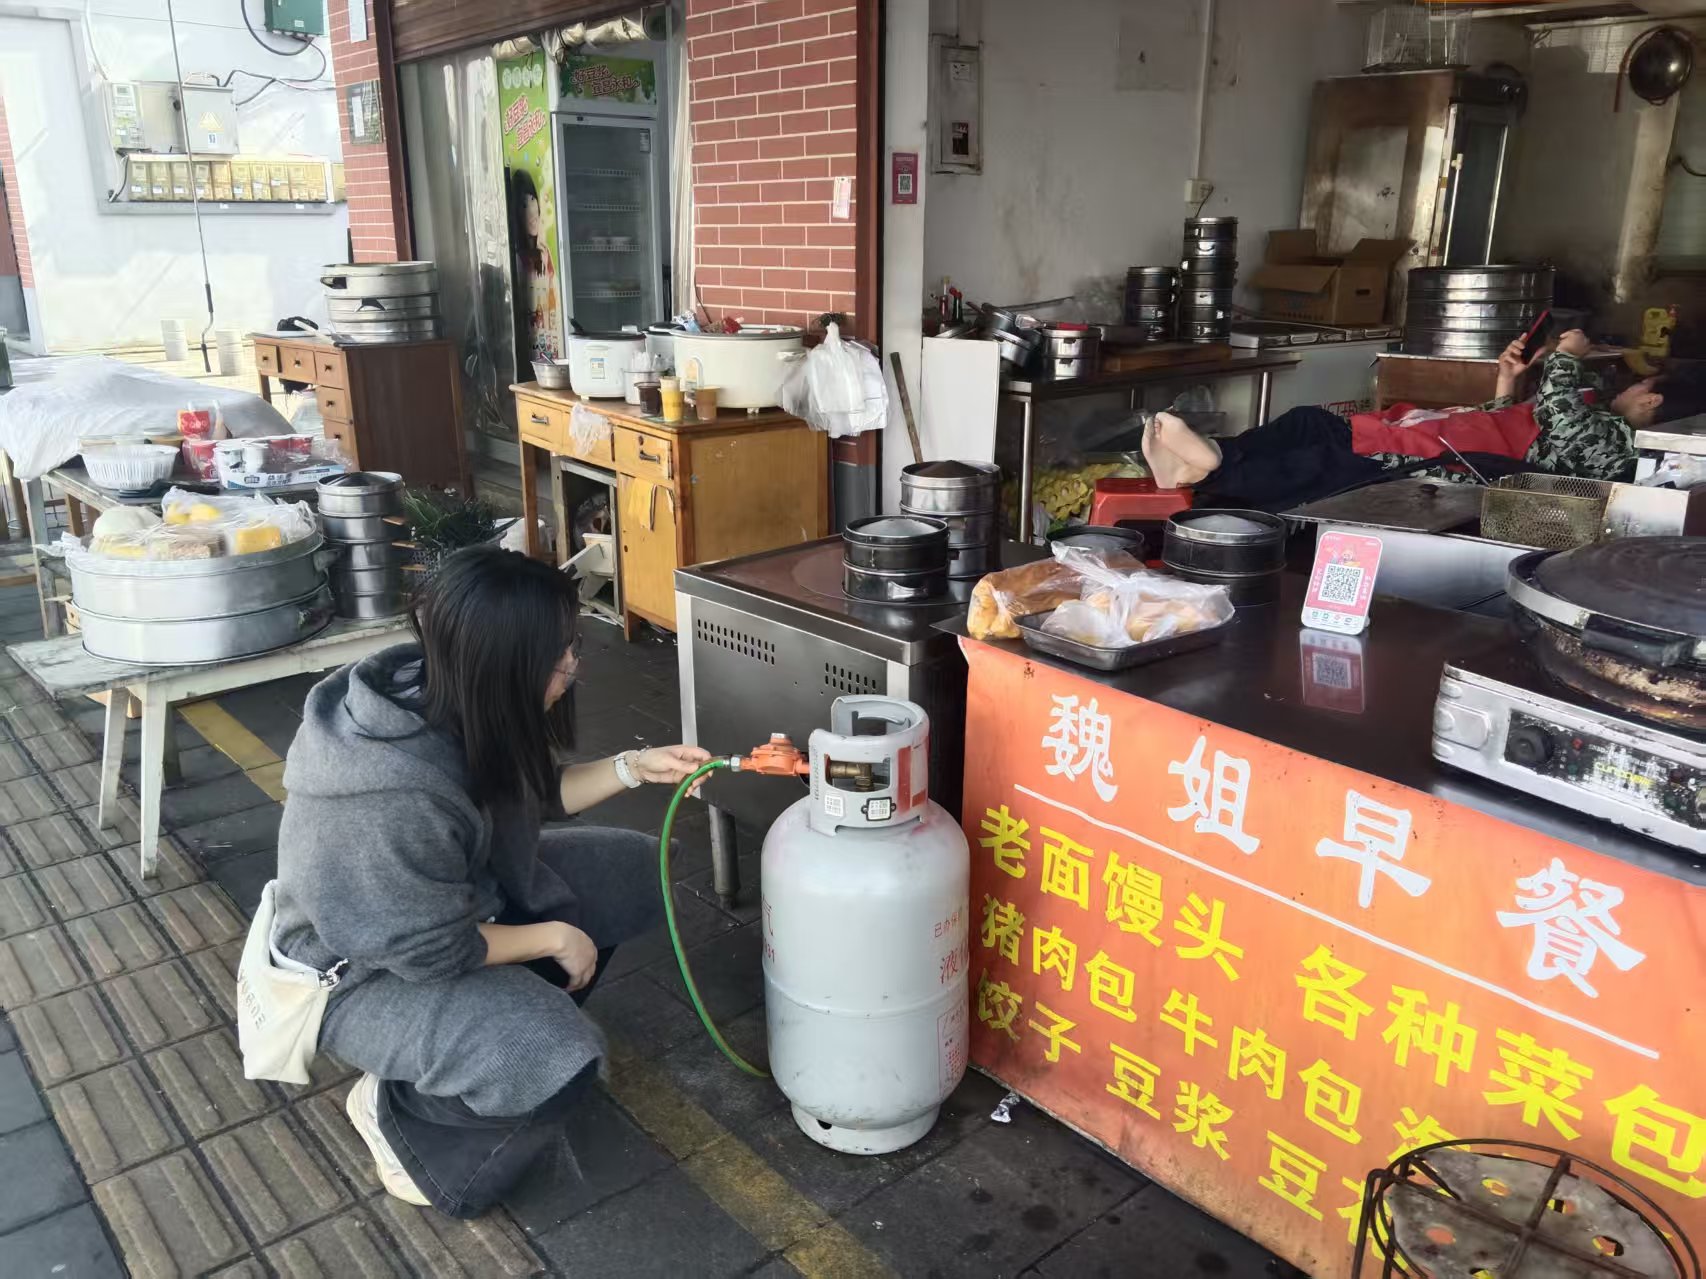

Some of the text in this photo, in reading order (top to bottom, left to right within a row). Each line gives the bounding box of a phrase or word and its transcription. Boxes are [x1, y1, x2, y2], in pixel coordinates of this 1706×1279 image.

[1041, 693, 1647, 999] 魏姐早餐
[975, 967, 1082, 1063] 饺子
[1105, 1042, 1233, 1160] 豆浆
[978, 804, 1706, 1198] 老面馒头 各种菜包
[980, 893, 1137, 1023] 猪肉包
[1159, 989, 1361, 1144] 牛肉包
